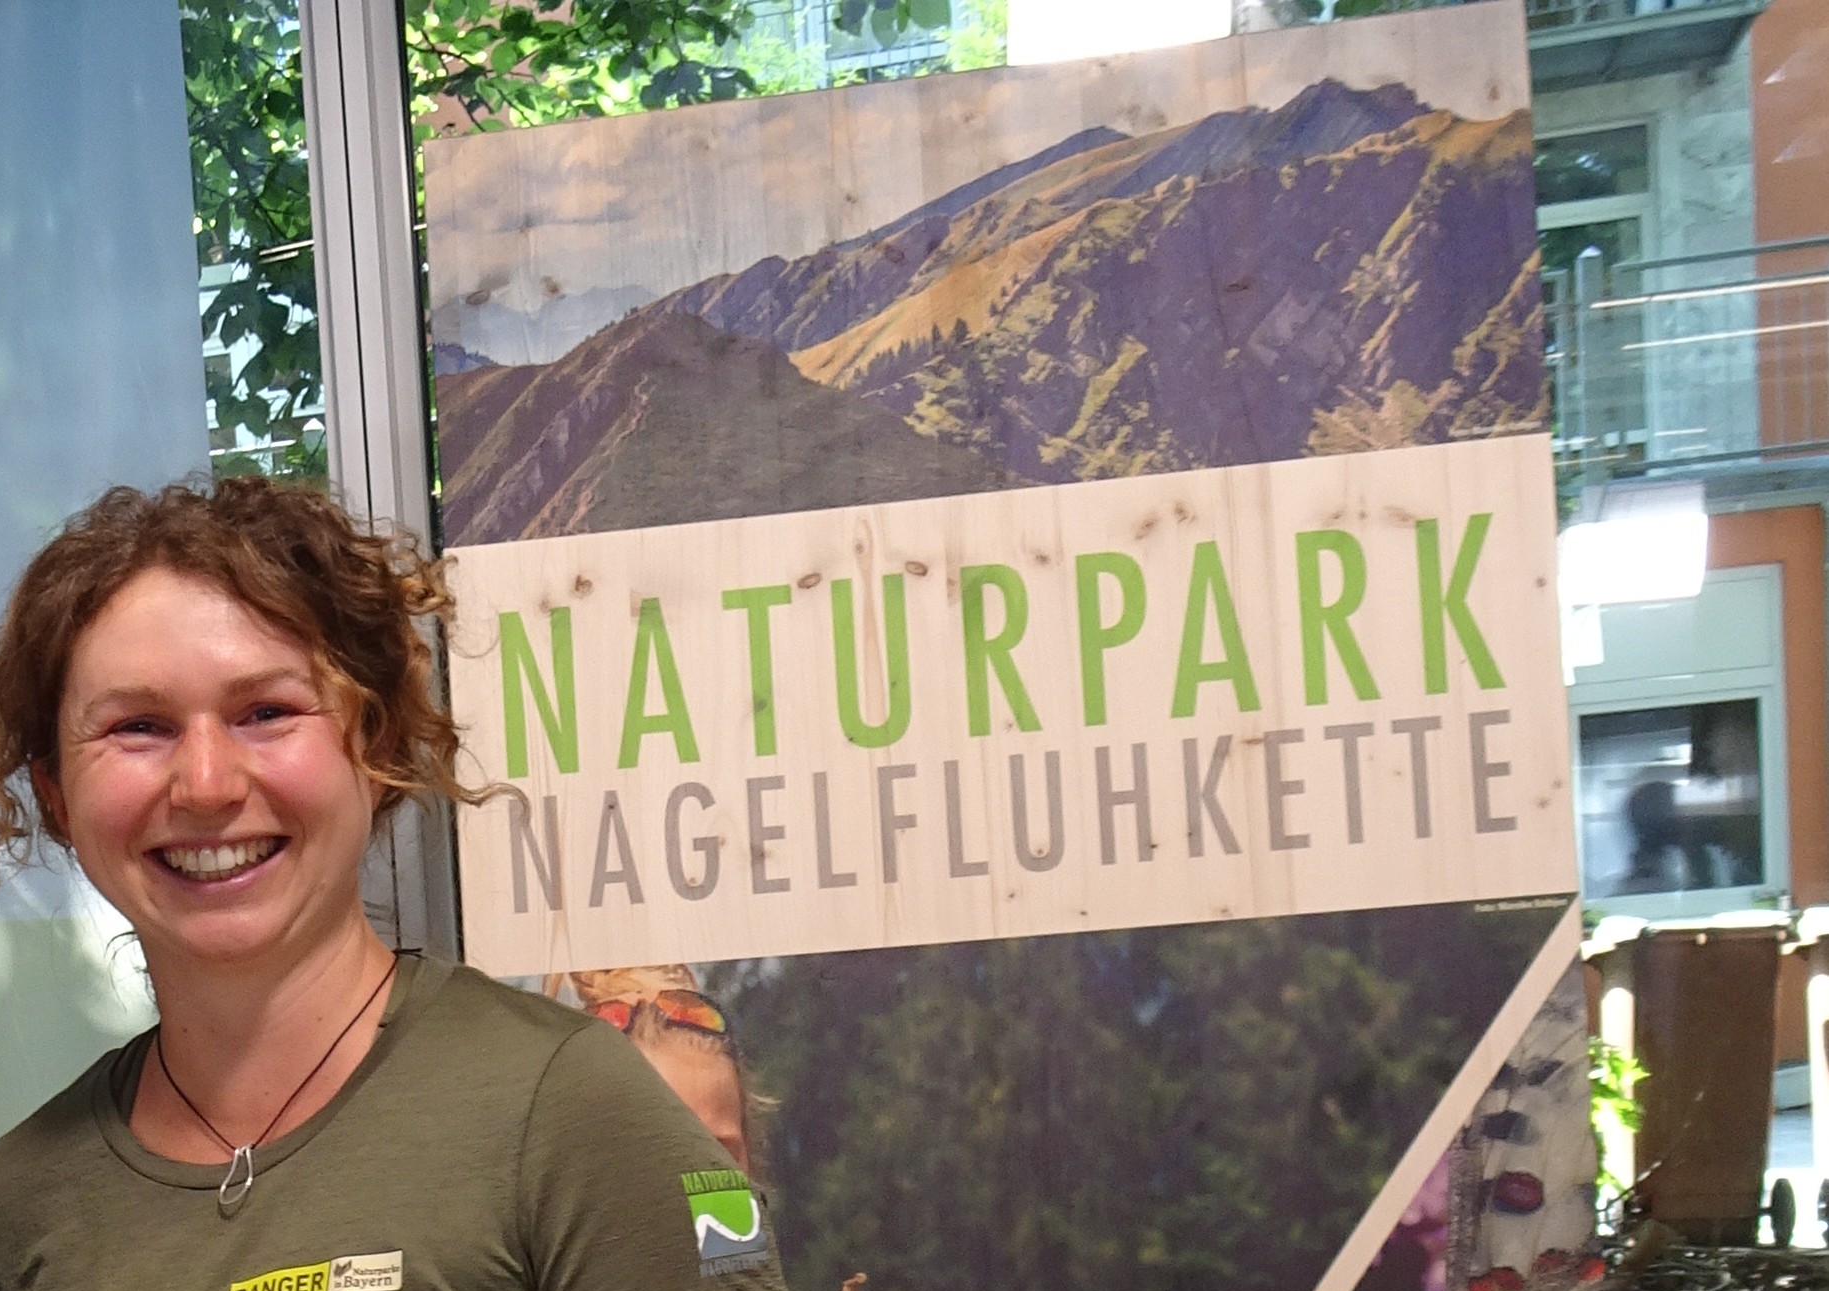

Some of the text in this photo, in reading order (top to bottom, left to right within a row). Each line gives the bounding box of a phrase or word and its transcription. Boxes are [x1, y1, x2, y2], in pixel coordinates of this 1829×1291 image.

[498, 511, 1509, 780] NATURPARK
[507, 709, 1518, 914] NAGELFLUHKETTE
[343, 1275, 394, 1290] Bayern
